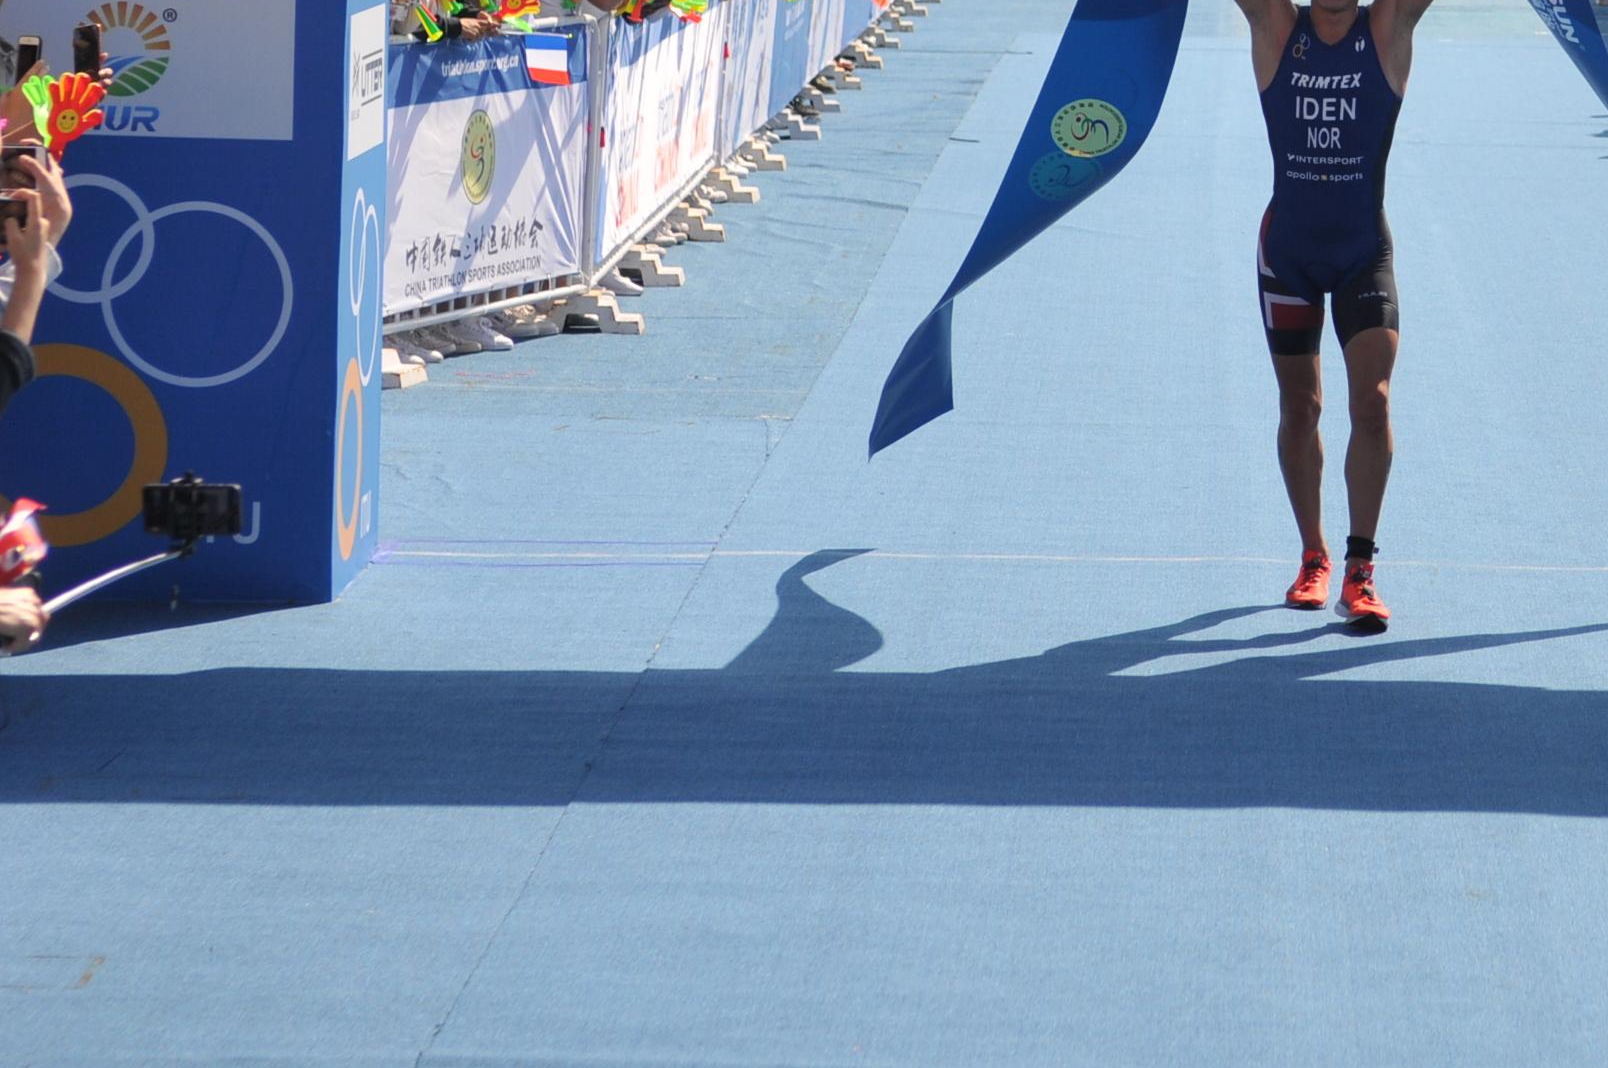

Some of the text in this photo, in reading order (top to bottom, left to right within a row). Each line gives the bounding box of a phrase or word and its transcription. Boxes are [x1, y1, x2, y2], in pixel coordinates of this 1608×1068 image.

[1290, 72, 1362, 89] TRIMTEX
[1295, 96, 1357, 121] IDEN
[1307, 127, 1341, 149] NOR
[1296, 154, 1364, 165] INTERSPORT
[1286, 170, 1364, 182] apollo sports
[405, 256, 541, 297] CHINA TRIATHLON SPORTS ASSOCIATION
